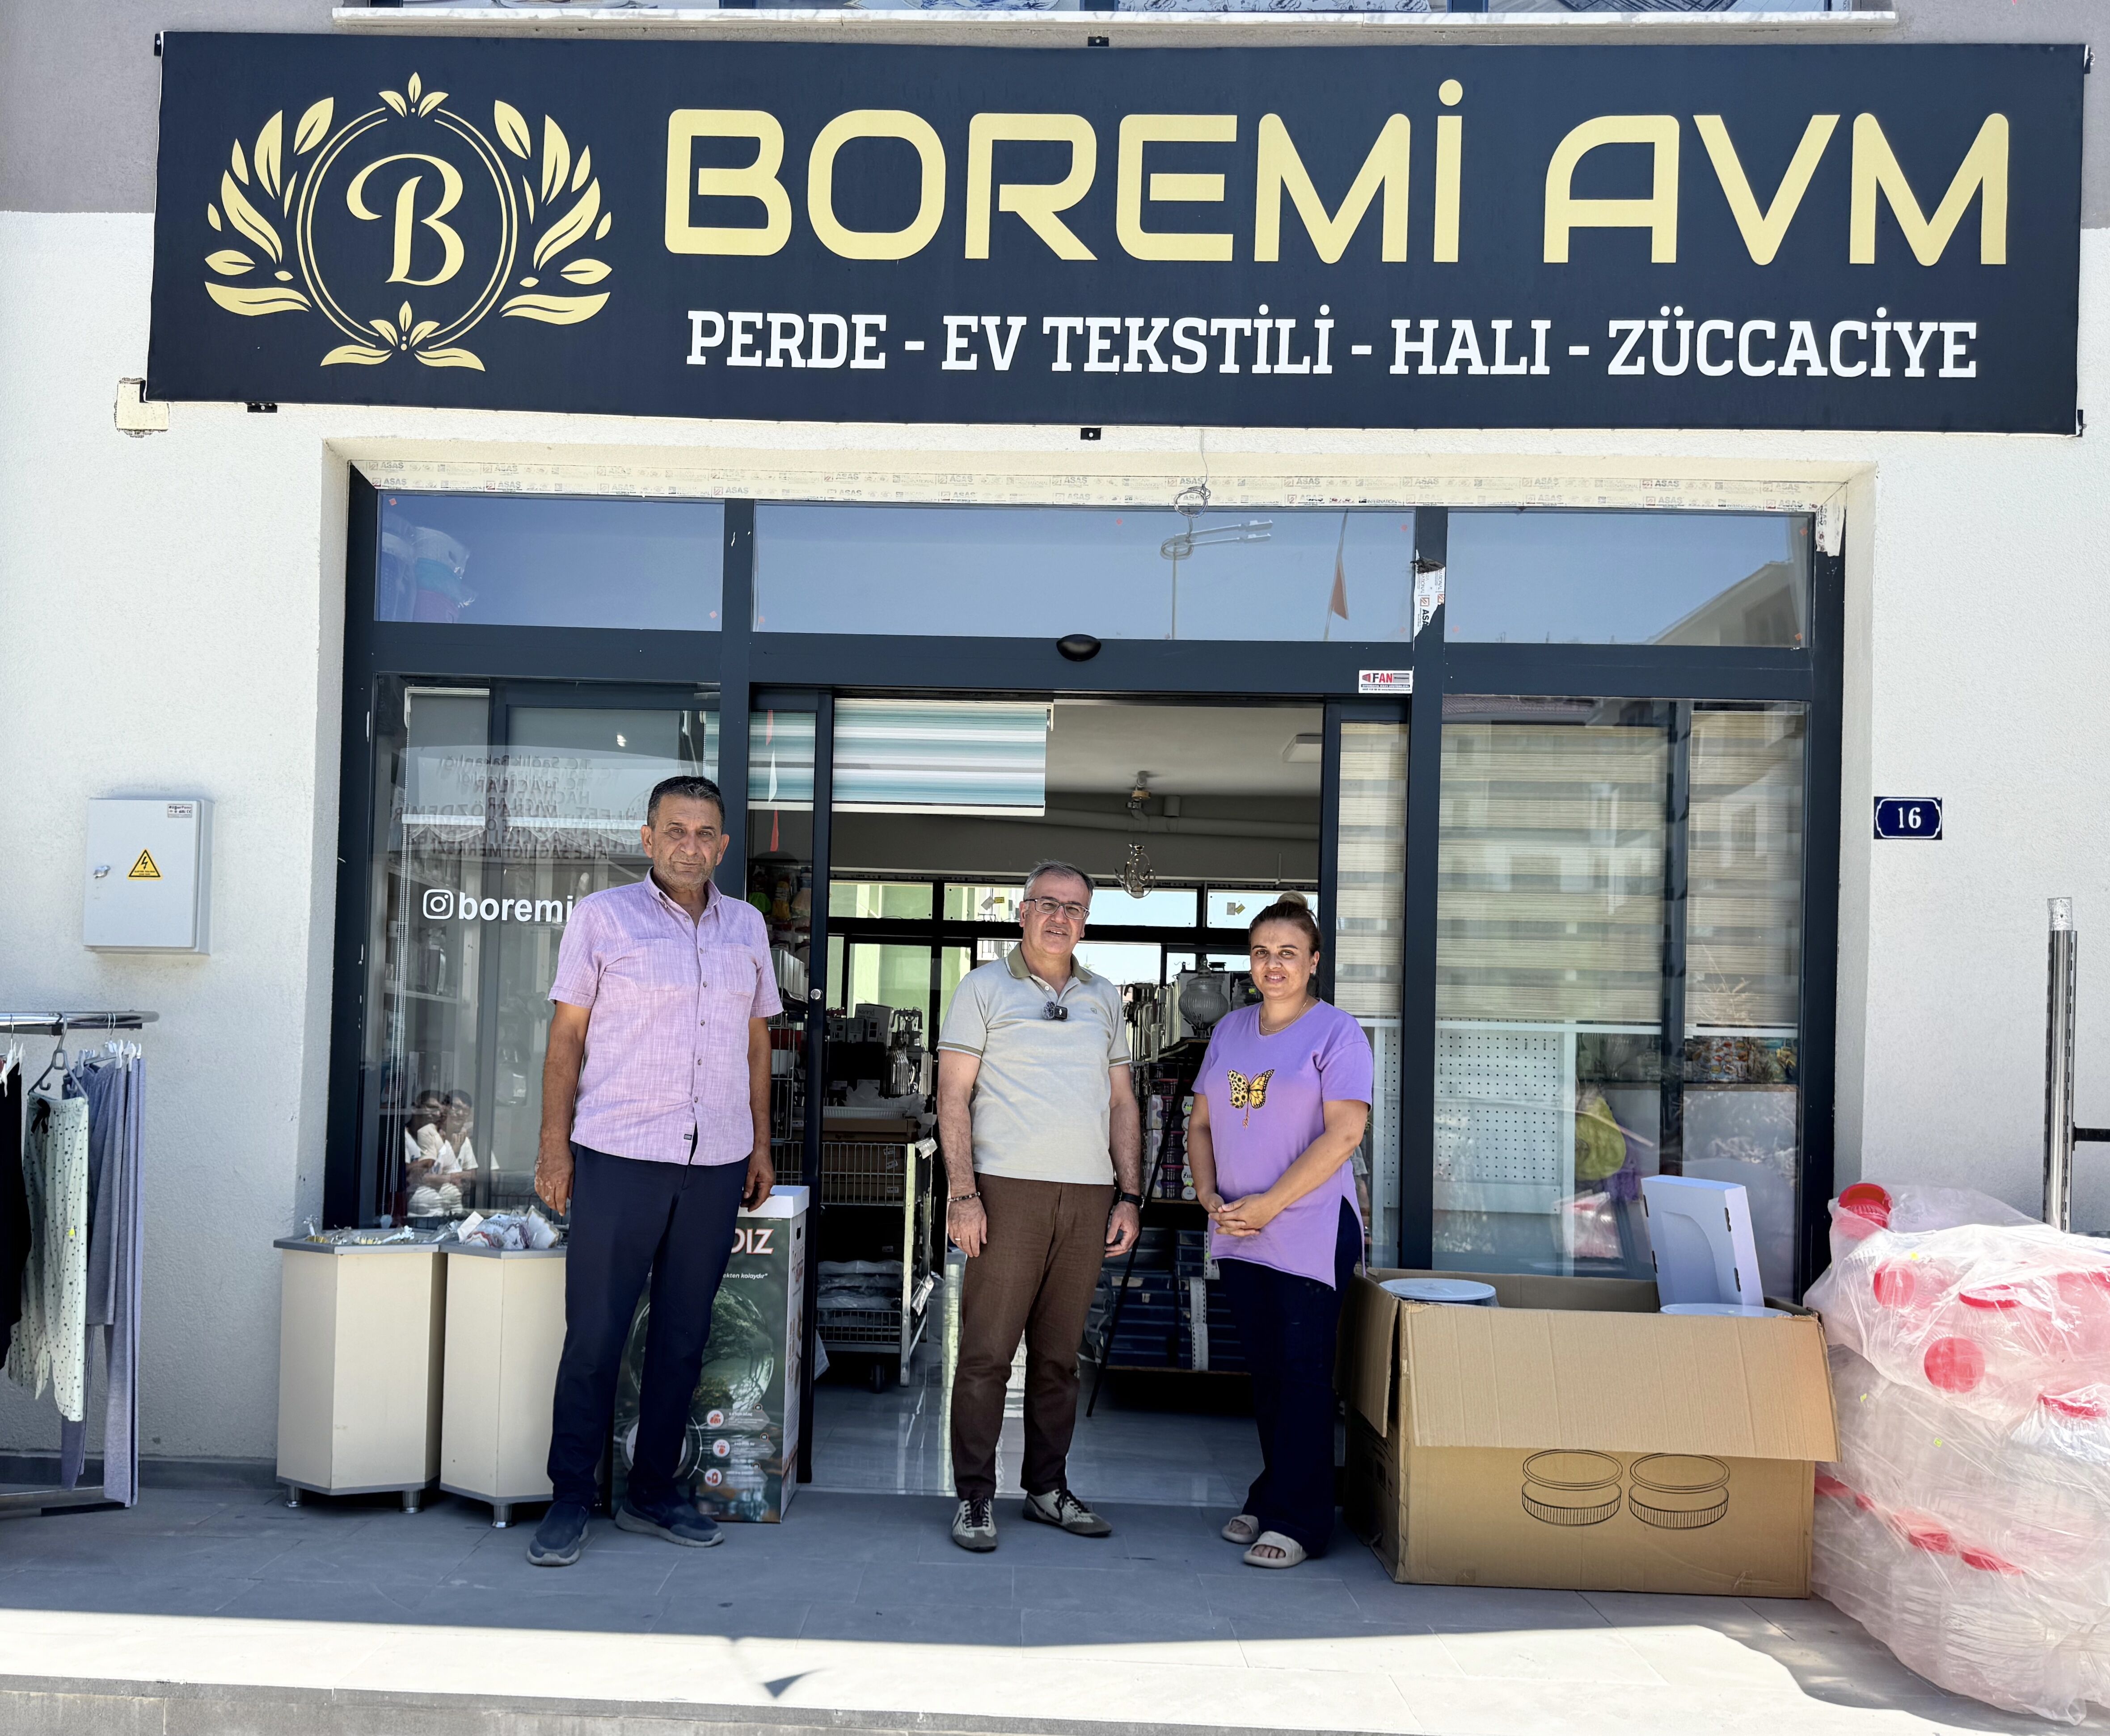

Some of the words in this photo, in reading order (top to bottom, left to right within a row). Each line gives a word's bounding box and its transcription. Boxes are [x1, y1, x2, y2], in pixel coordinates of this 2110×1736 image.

[665, 79, 1463, 264] BOREMİ
[1544, 113, 2009, 266] AVM
[346, 154, 464, 286] B
[687, 311, 887, 369] PERDE
[905, 341, 924, 350] -
[942, 316, 1027, 371] EV
[1043, 304, 1334, 374] TEKSTİLİ
[1351, 346, 1372, 354] -
[1390, 320, 1551, 375] HALI
[1569, 346, 1589, 355] -
[1608, 306, 1977, 378] ZÜCCACİYE
[1373, 673, 1393, 683] FAN
[1898, 807, 1921, 829] 16
[459, 892, 574, 923] boremi
